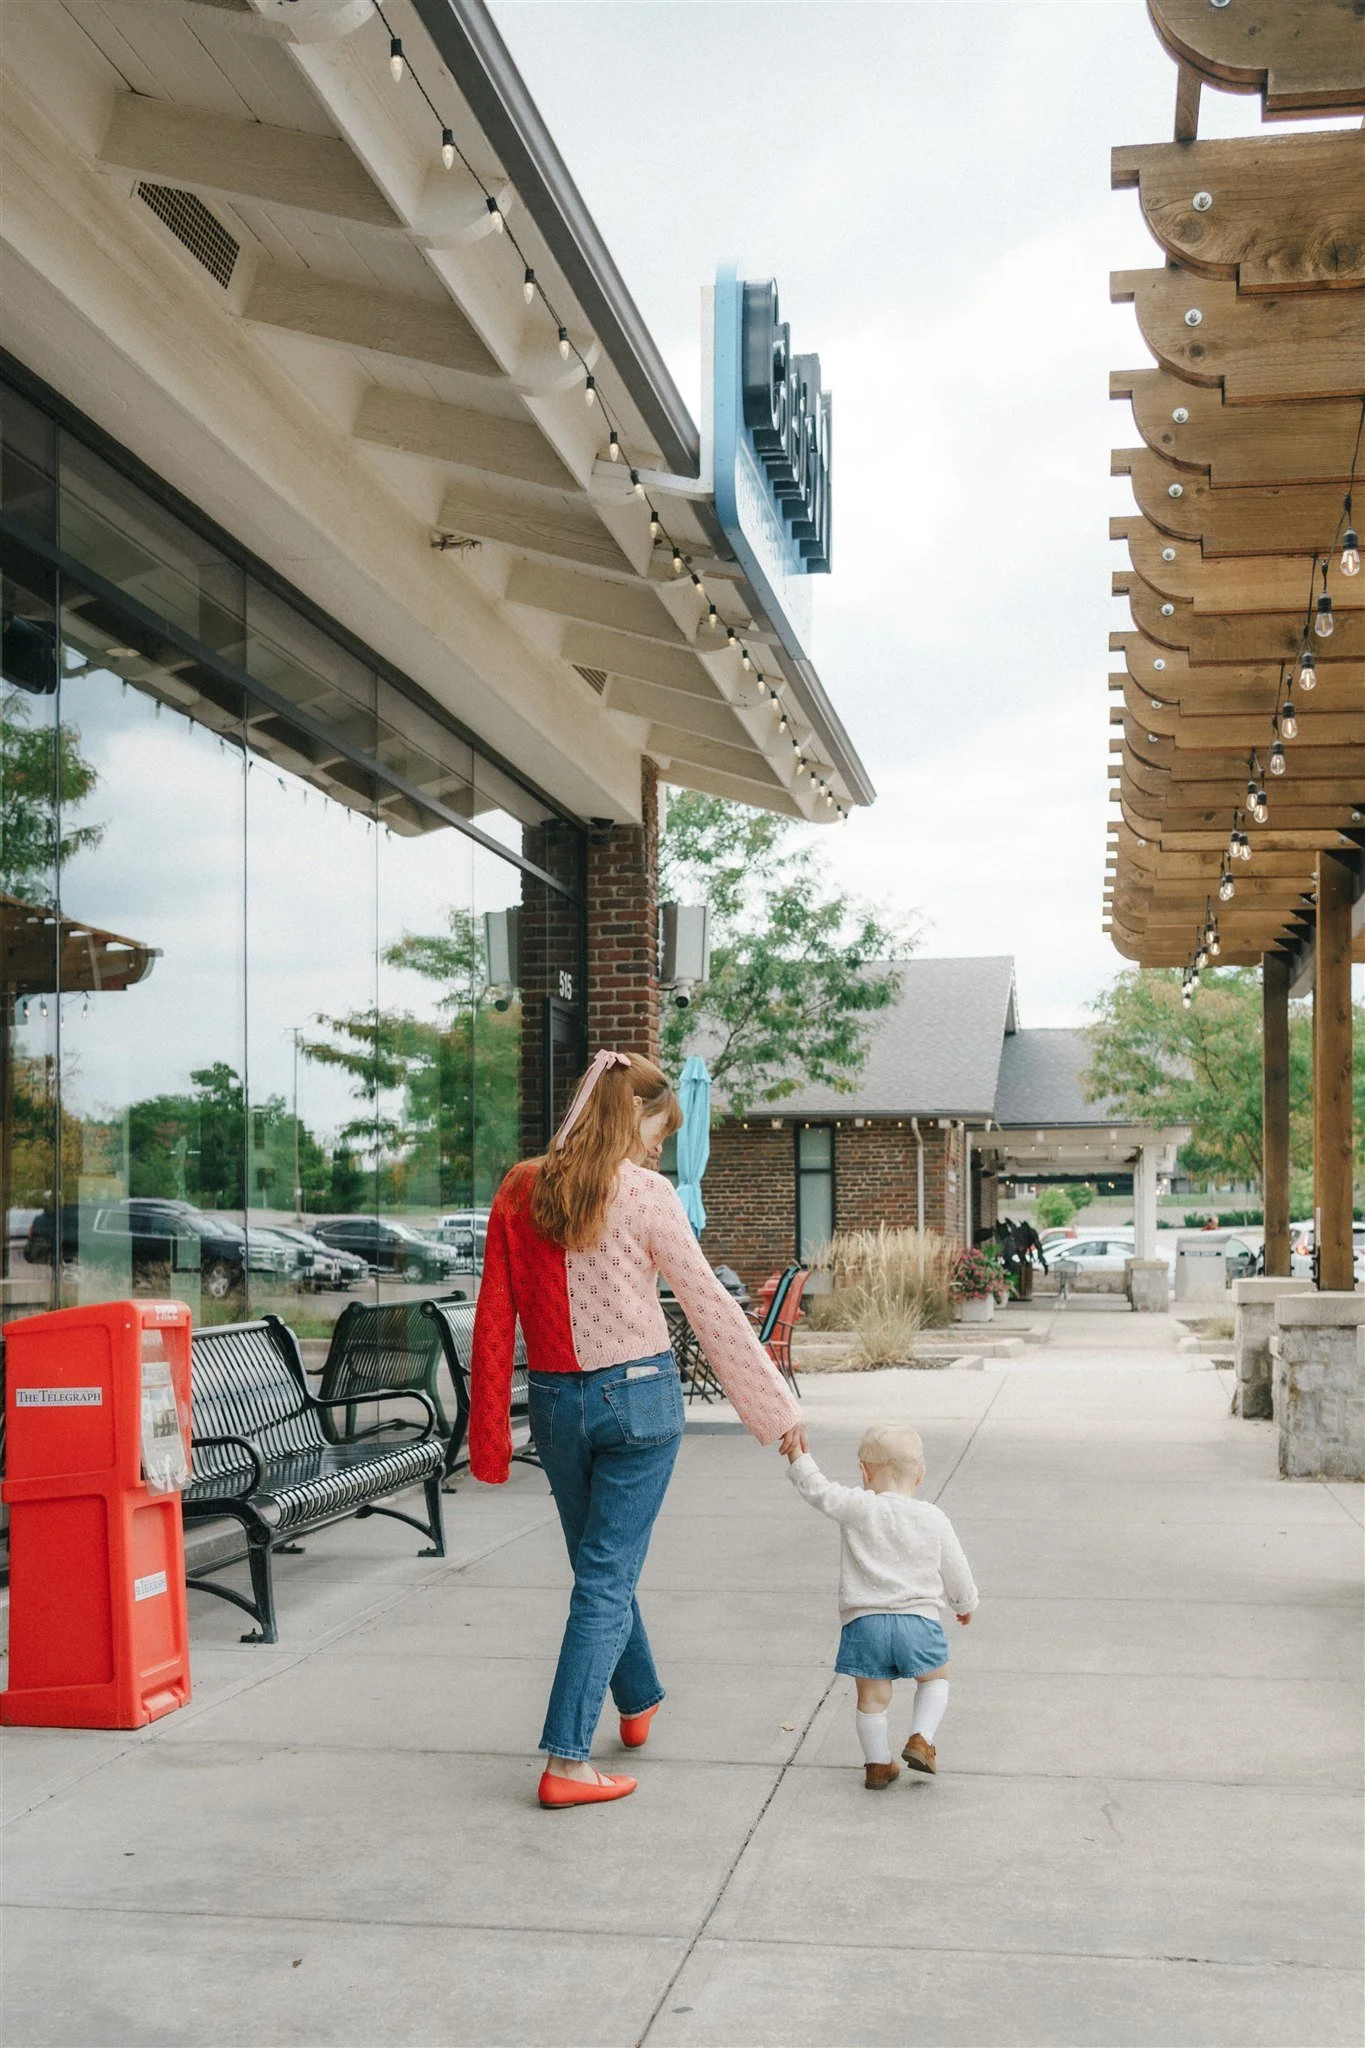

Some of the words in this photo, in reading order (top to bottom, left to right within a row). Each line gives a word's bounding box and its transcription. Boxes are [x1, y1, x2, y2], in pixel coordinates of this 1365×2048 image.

[559, 970, 572, 1000] 515
[17, 1391, 39, 1402] THE
[39, 1390, 101, 1402] TELEGRAPH
